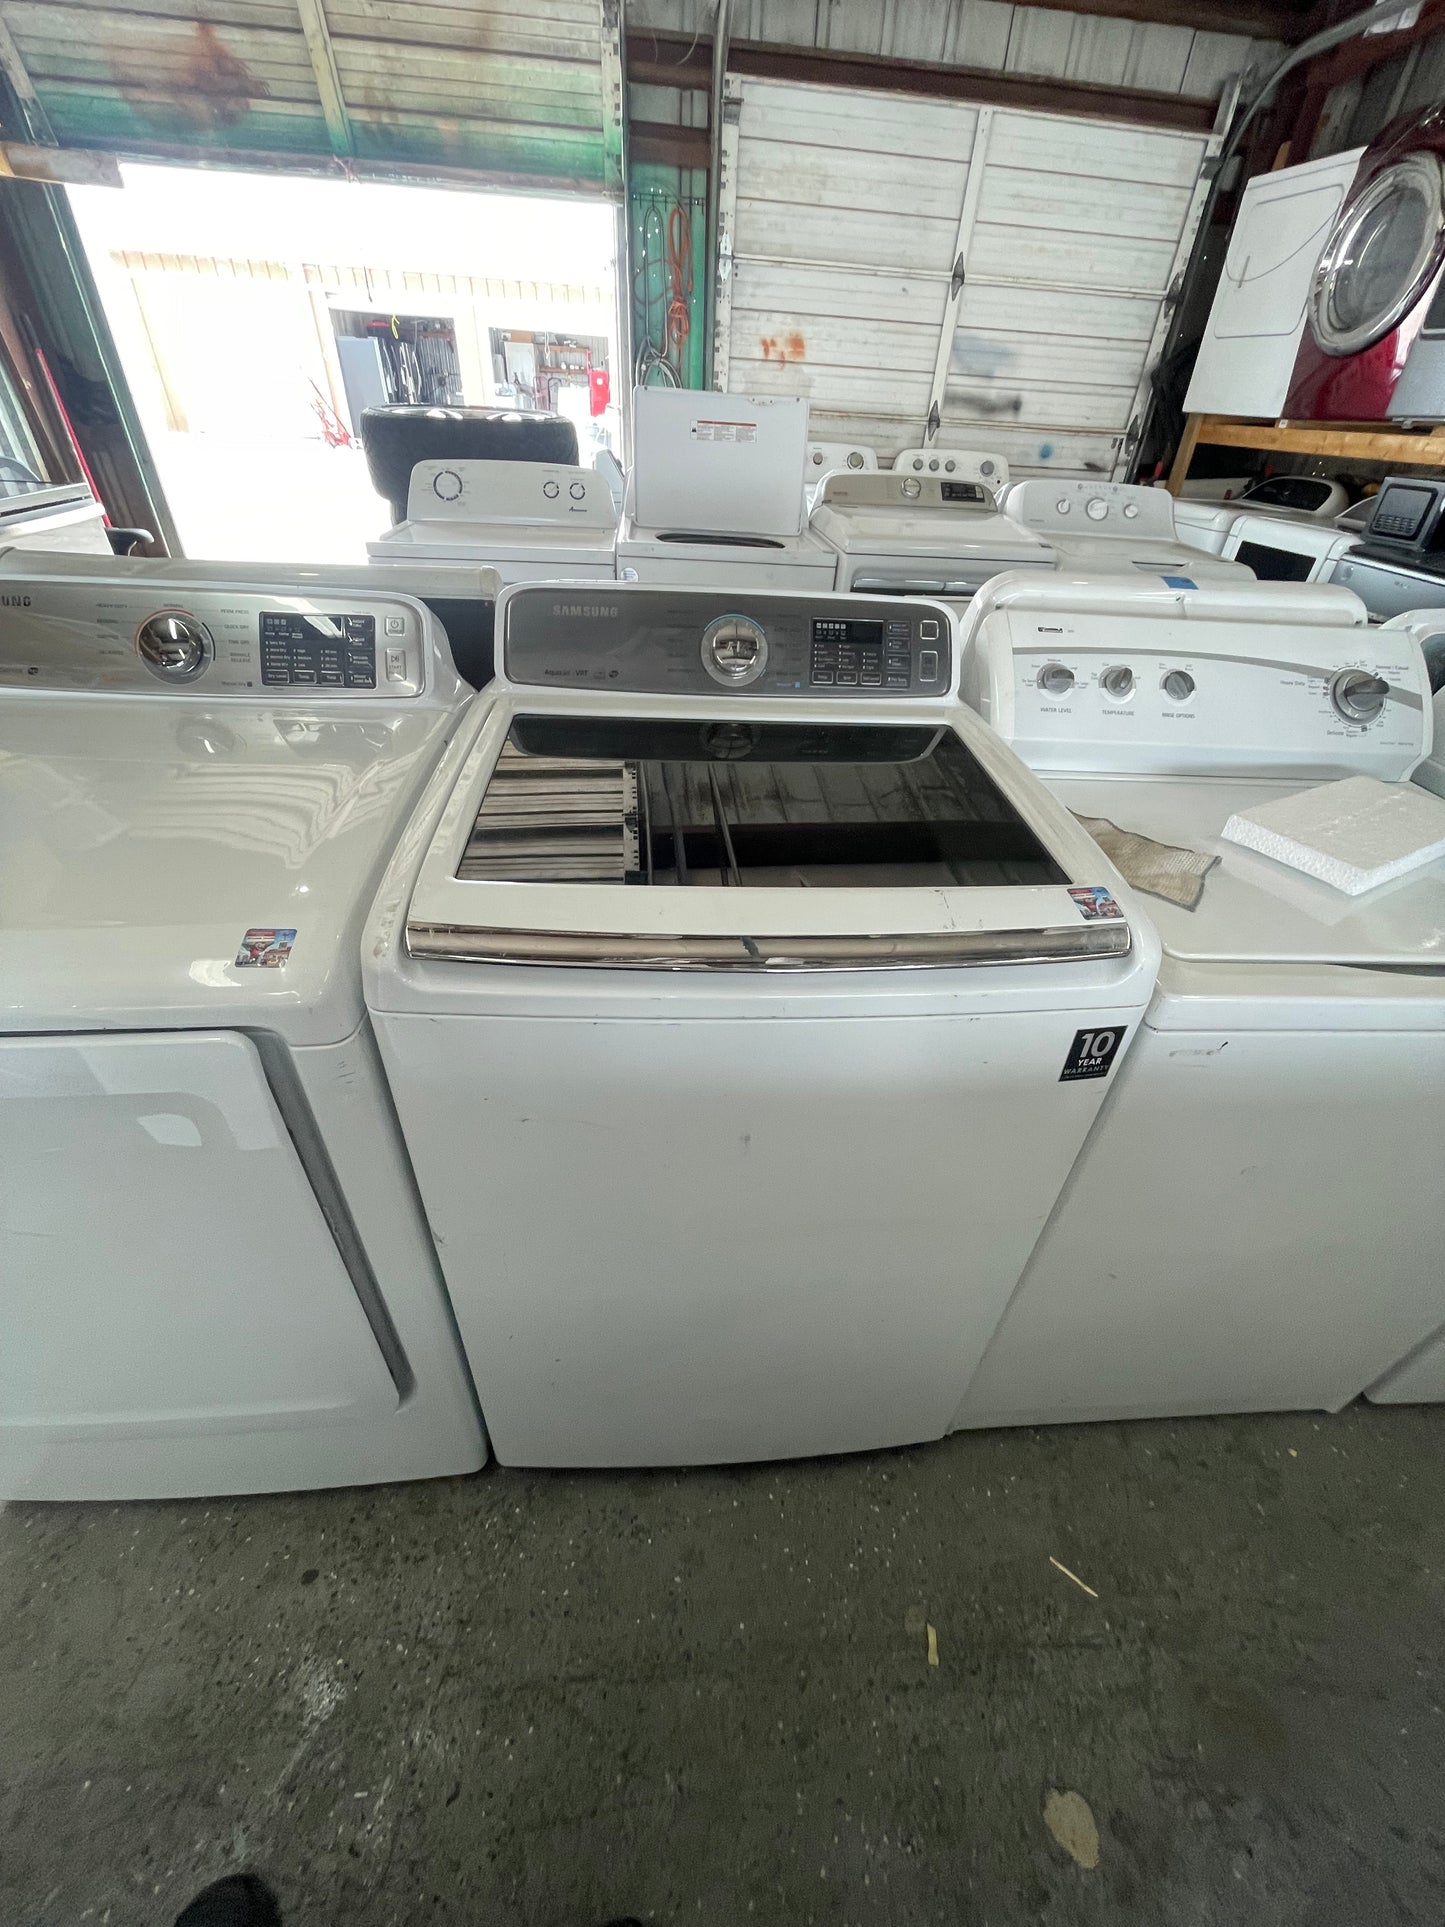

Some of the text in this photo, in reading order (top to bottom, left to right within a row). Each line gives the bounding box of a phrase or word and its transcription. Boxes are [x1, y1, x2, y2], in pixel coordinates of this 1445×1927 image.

[553, 605, 618, 617] SAMSUNG
[1080, 1031, 1116, 1058] 10
[1078, 1057, 1103, 1066] YEAR
